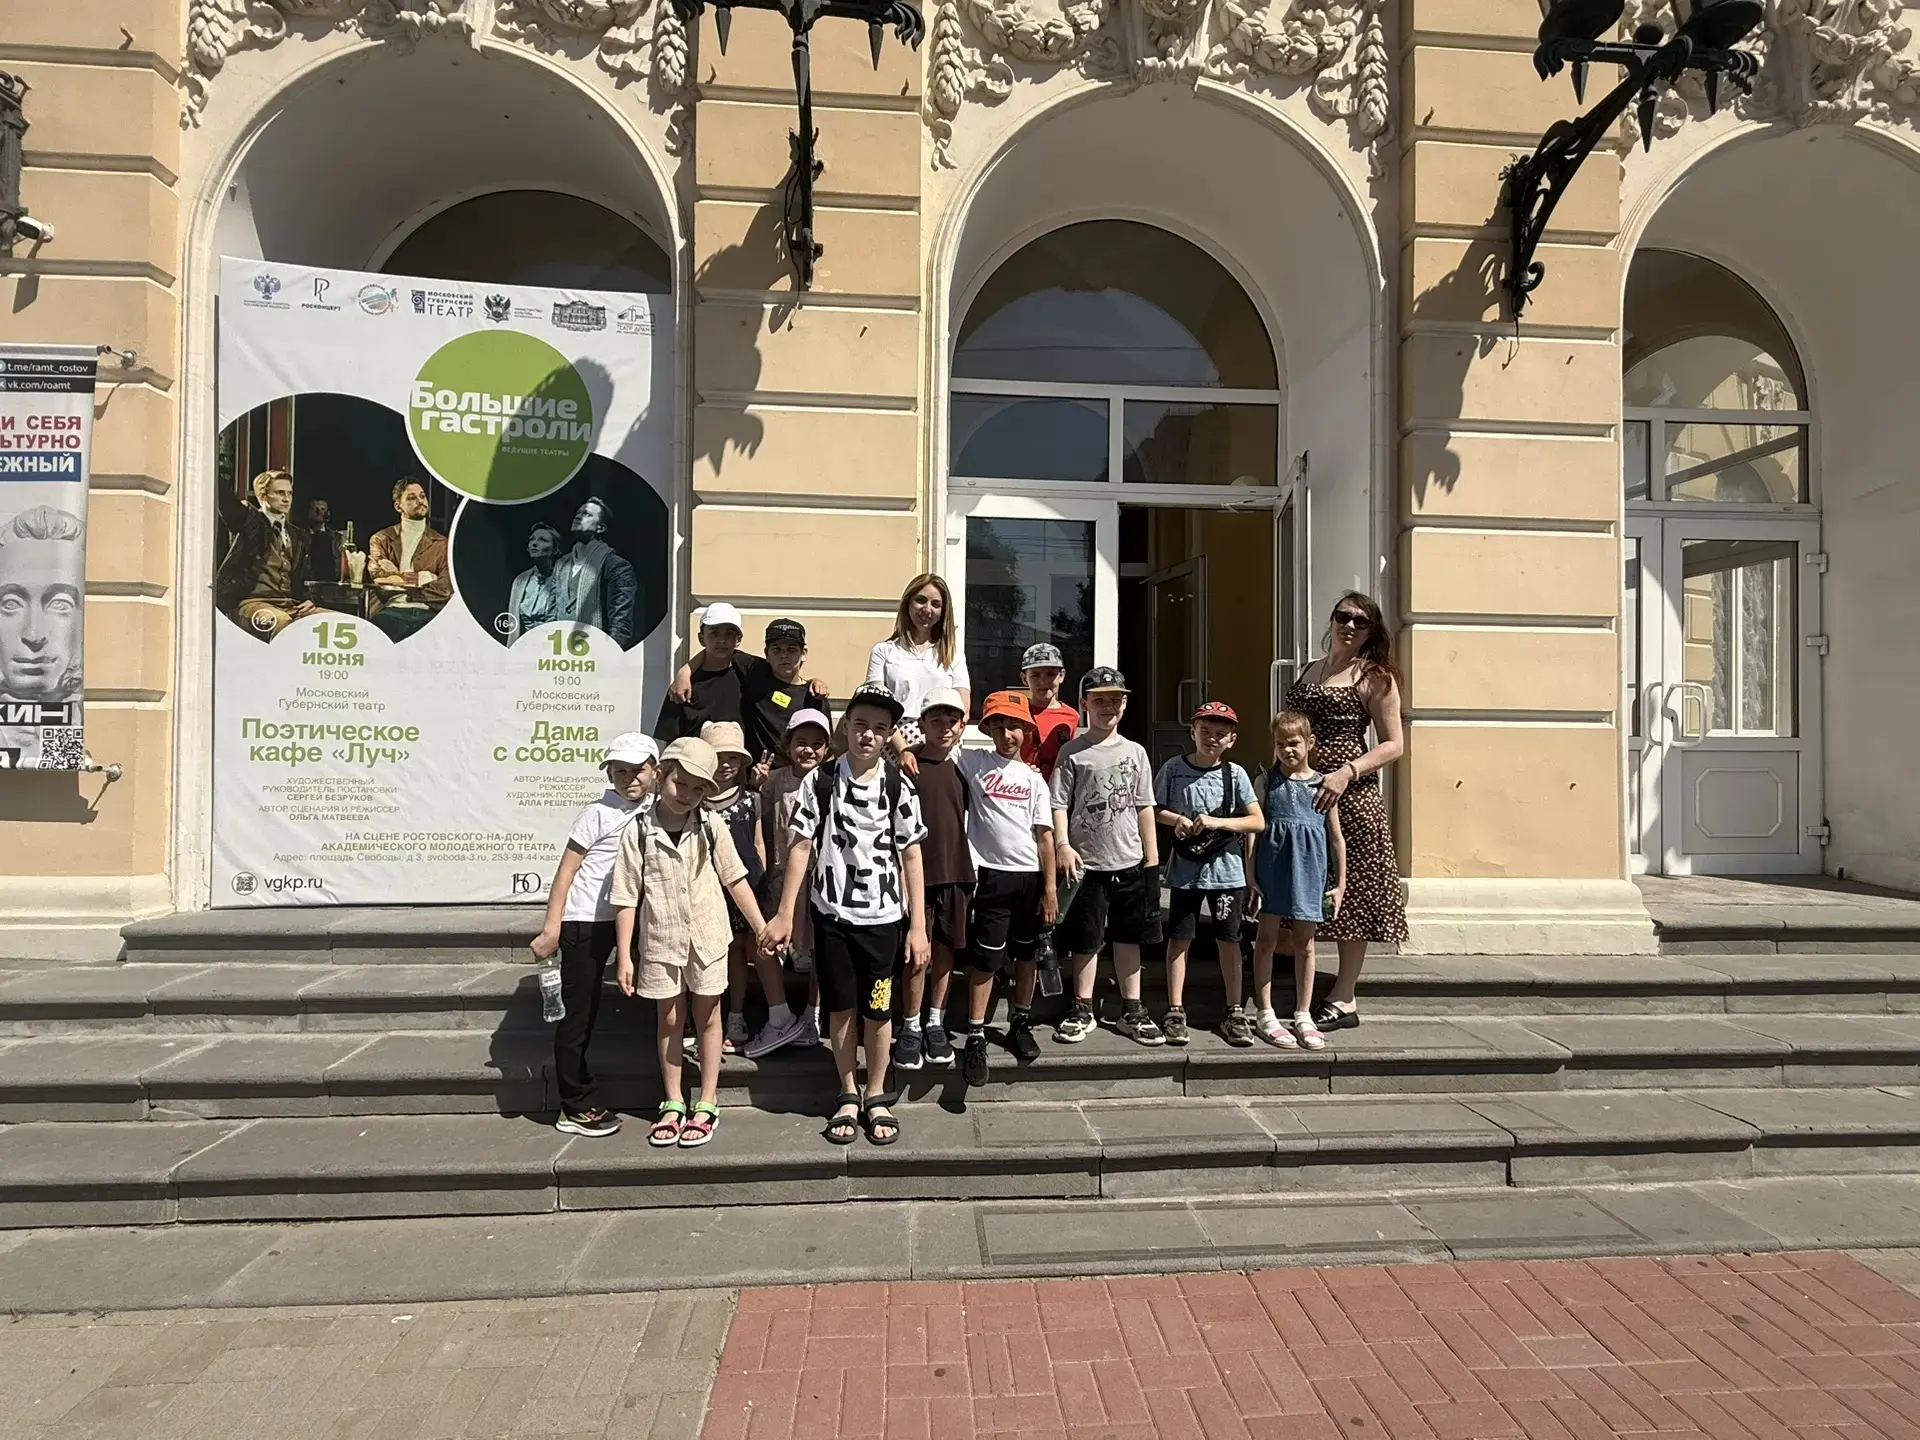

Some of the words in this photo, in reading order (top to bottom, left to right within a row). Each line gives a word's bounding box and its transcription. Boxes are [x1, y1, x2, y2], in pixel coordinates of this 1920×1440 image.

[428, 291, 473, 300] МОСКОВСКИЙ
[428, 304, 473, 318] ТЕАТР
[8, 363, 89, 374] t.me/ramt_rostov
[8, 381, 71, 390] vk.com/roamt
[411, 380, 578, 420] Большие
[0, 415, 15, 432] И
[26, 415, 81, 430] СЕБЯ
[421, 410, 593, 443] гастроли
[502, 446, 538, 455] ВЕДУЩИЕ
[540, 448, 570, 457] ТЕАТРЫ
[0, 453, 75, 473] ЖНЫЙ
[497, 619, 515, 628] 16+
[312, 622, 359, 649] 15
[547, 629, 590, 656] 16
[302, 652, 364, 666] июня
[538, 658, 595, 672] июня
[318, 670, 348, 680] 19:00
[553, 676, 581, 686] 19:00
[296, 687, 369, 699] Московский
[532, 690, 600, 700] Московский
[279, 699, 348, 711] Губернский
[352, 702, 386, 712] театр
[516, 700, 581, 712] Губернский
[585, 704, 615, 714] театр
[242, 718, 420, 741] Поэтическое
[530, 721, 599, 744] Дама
[250, 742, 323, 767] кафе
[332, 743, 410, 768] «Луч»
[493, 746, 507, 762] с
[287, 777, 375, 786] ХУДОЖЕСТВЕННЫЙ
[983, 773, 1031, 796] Union
[262, 785, 335, 794] РУКОВОДИТЕЛЬ
[337, 786, 397, 794] ПОСТАНОВКИ
[287, 792, 323, 801] СЕРГЕЙ
[519, 799, 541, 807] АЛЛА
[258, 805, 289, 813] АВТОР
[290, 805, 340, 814] СЦЕНАРИЯ
[342, 805, 348, 813] И
[350, 805, 400, 813] РЕЖИССЕР
[289, 813, 319, 821] ОЛЬГА
[345, 832, 361, 841] НА
[363, 832, 400, 842] СЦЕНЕ
[402, 832, 535, 842] РОСТОВСКОГО-НА-ДОНУ
[320, 842, 426, 851] АКАДЕМИЧЕСКОГО
[518, 843, 556, 851] ТЕАТРА
[273, 853, 306, 863] Адрес:
[309, 854, 354, 862] площадь
[491, 853, 537, 861] 253-98-44
[264, 875, 323, 892] vgkp.ru
